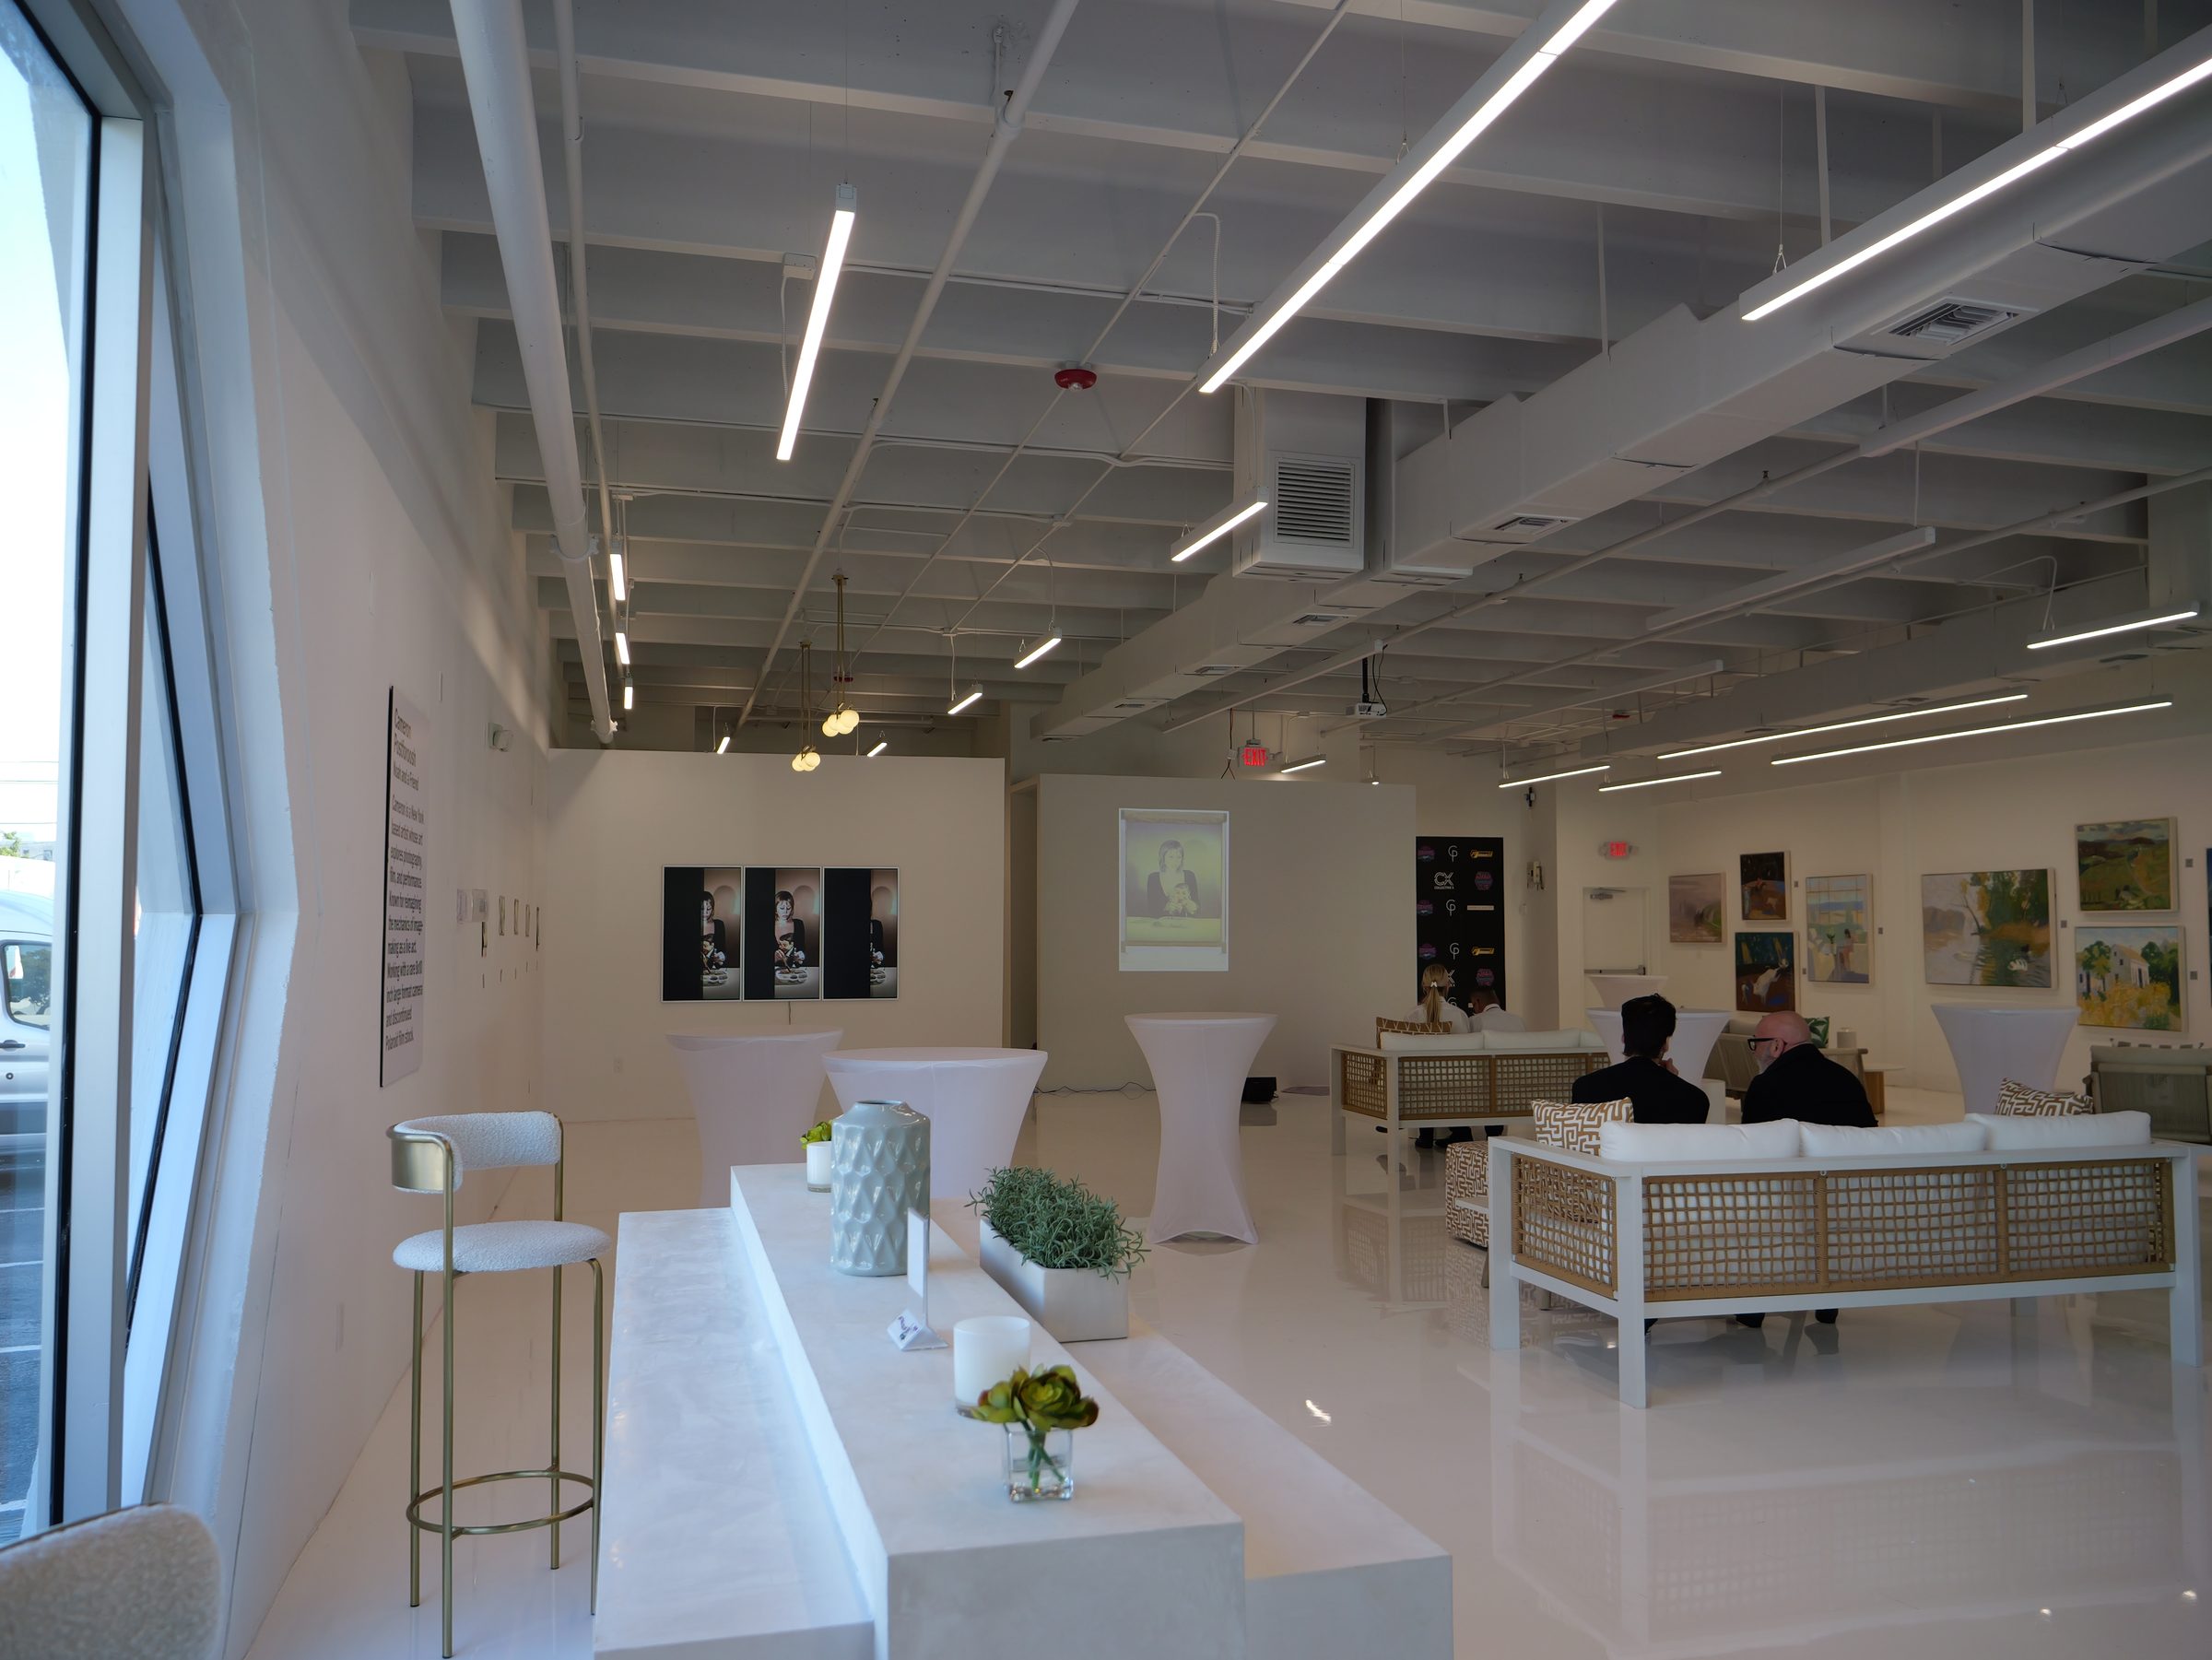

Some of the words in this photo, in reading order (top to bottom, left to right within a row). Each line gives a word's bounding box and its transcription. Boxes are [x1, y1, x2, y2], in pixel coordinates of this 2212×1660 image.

[394, 708, 411, 739] Cameron
[1244, 748, 1266, 767] EXIT
[410, 771, 419, 791] Friend
[392, 794, 406, 816] Cameron
[392, 818, 400, 837] based
[401, 825, 409, 842] artist
[409, 828, 418, 845] whose
[391, 843, 404, 865] explores
[389, 890, 399, 908] Known
[405, 893, 421, 914] reimagining
[394, 915, 410, 932] mechanics
[388, 937, 399, 958] making
[387, 962, 400, 982] Working
[402, 983, 412, 999] format
[412, 985, 423, 996] camera
[393, 1004, 412, 1026] discontinued
[385, 1031, 398, 1051] Polaroid
